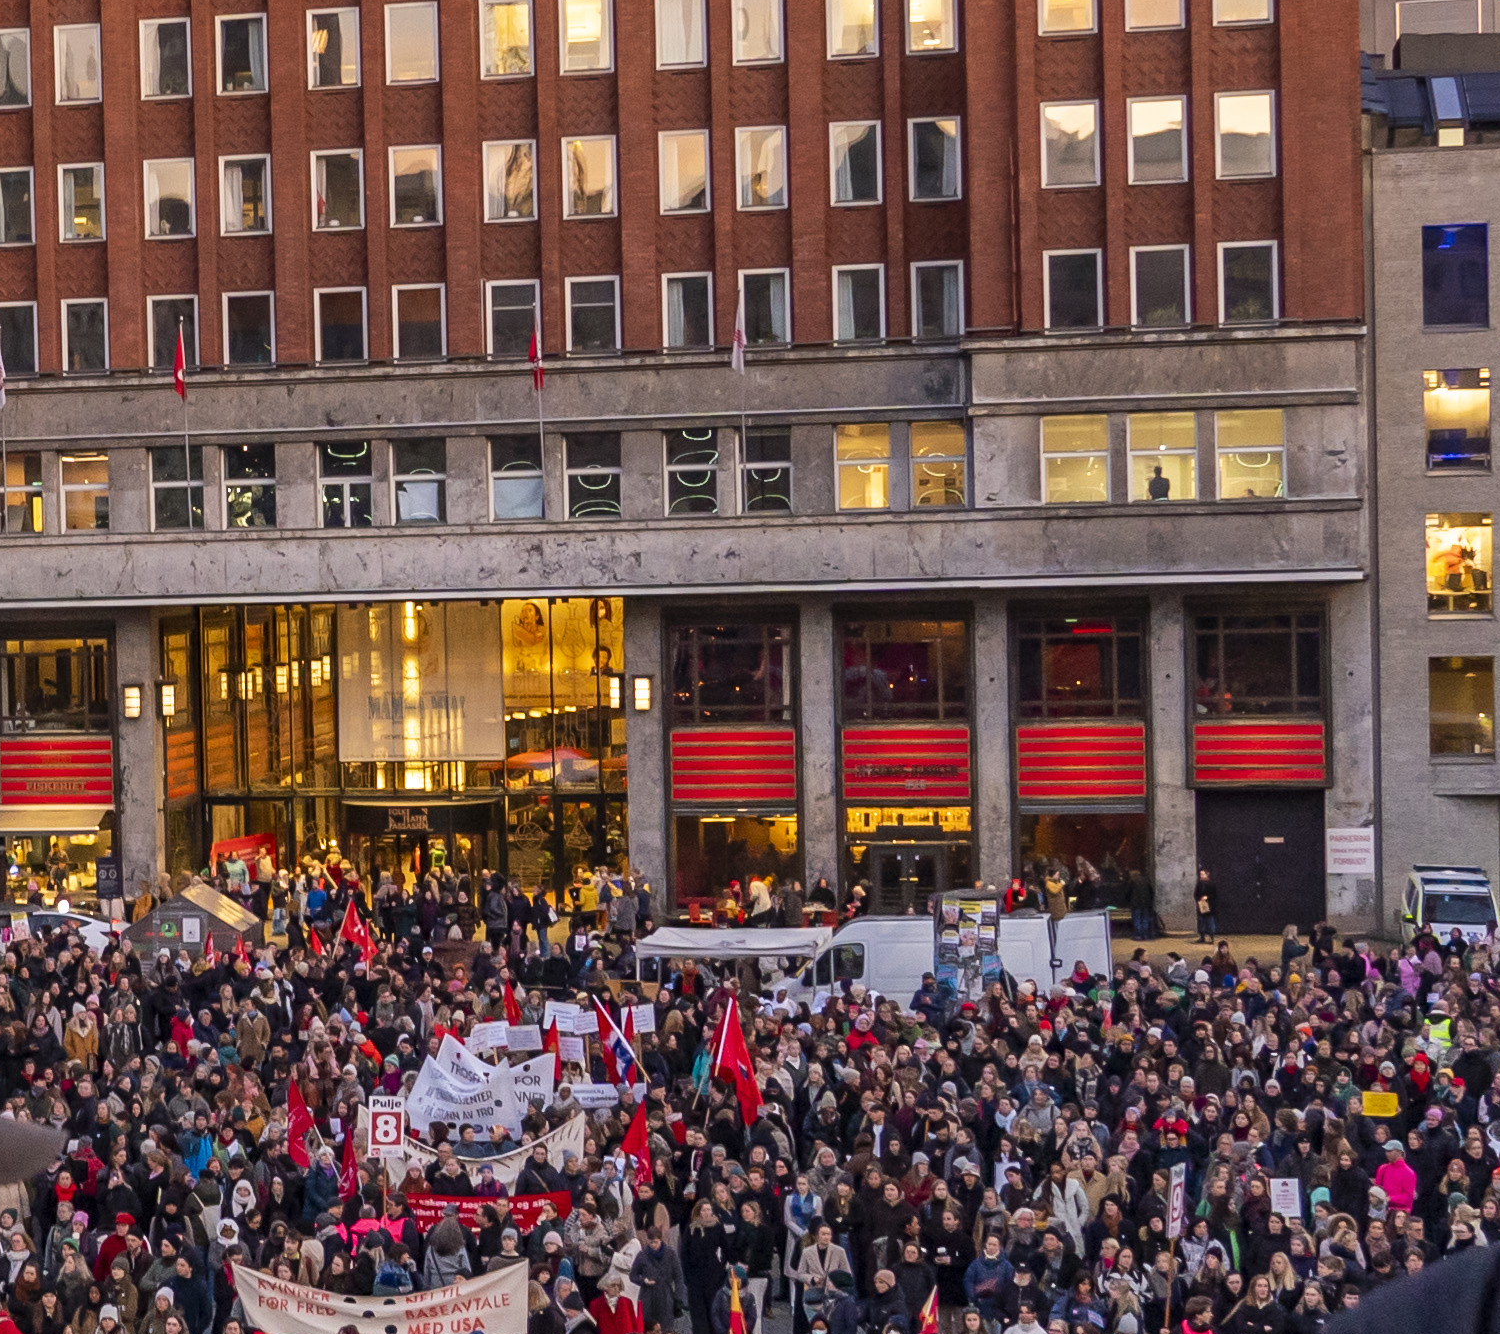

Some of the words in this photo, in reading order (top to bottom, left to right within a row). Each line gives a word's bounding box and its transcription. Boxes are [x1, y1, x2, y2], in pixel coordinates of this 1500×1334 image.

[514, 1075, 541, 1087] FOR
[372, 1098, 402, 1109] Pulje
[375, 1114, 398, 1144] 8
[256, 1277, 331, 1303] KVINNER
[450, 1317, 486, 1334] USA
